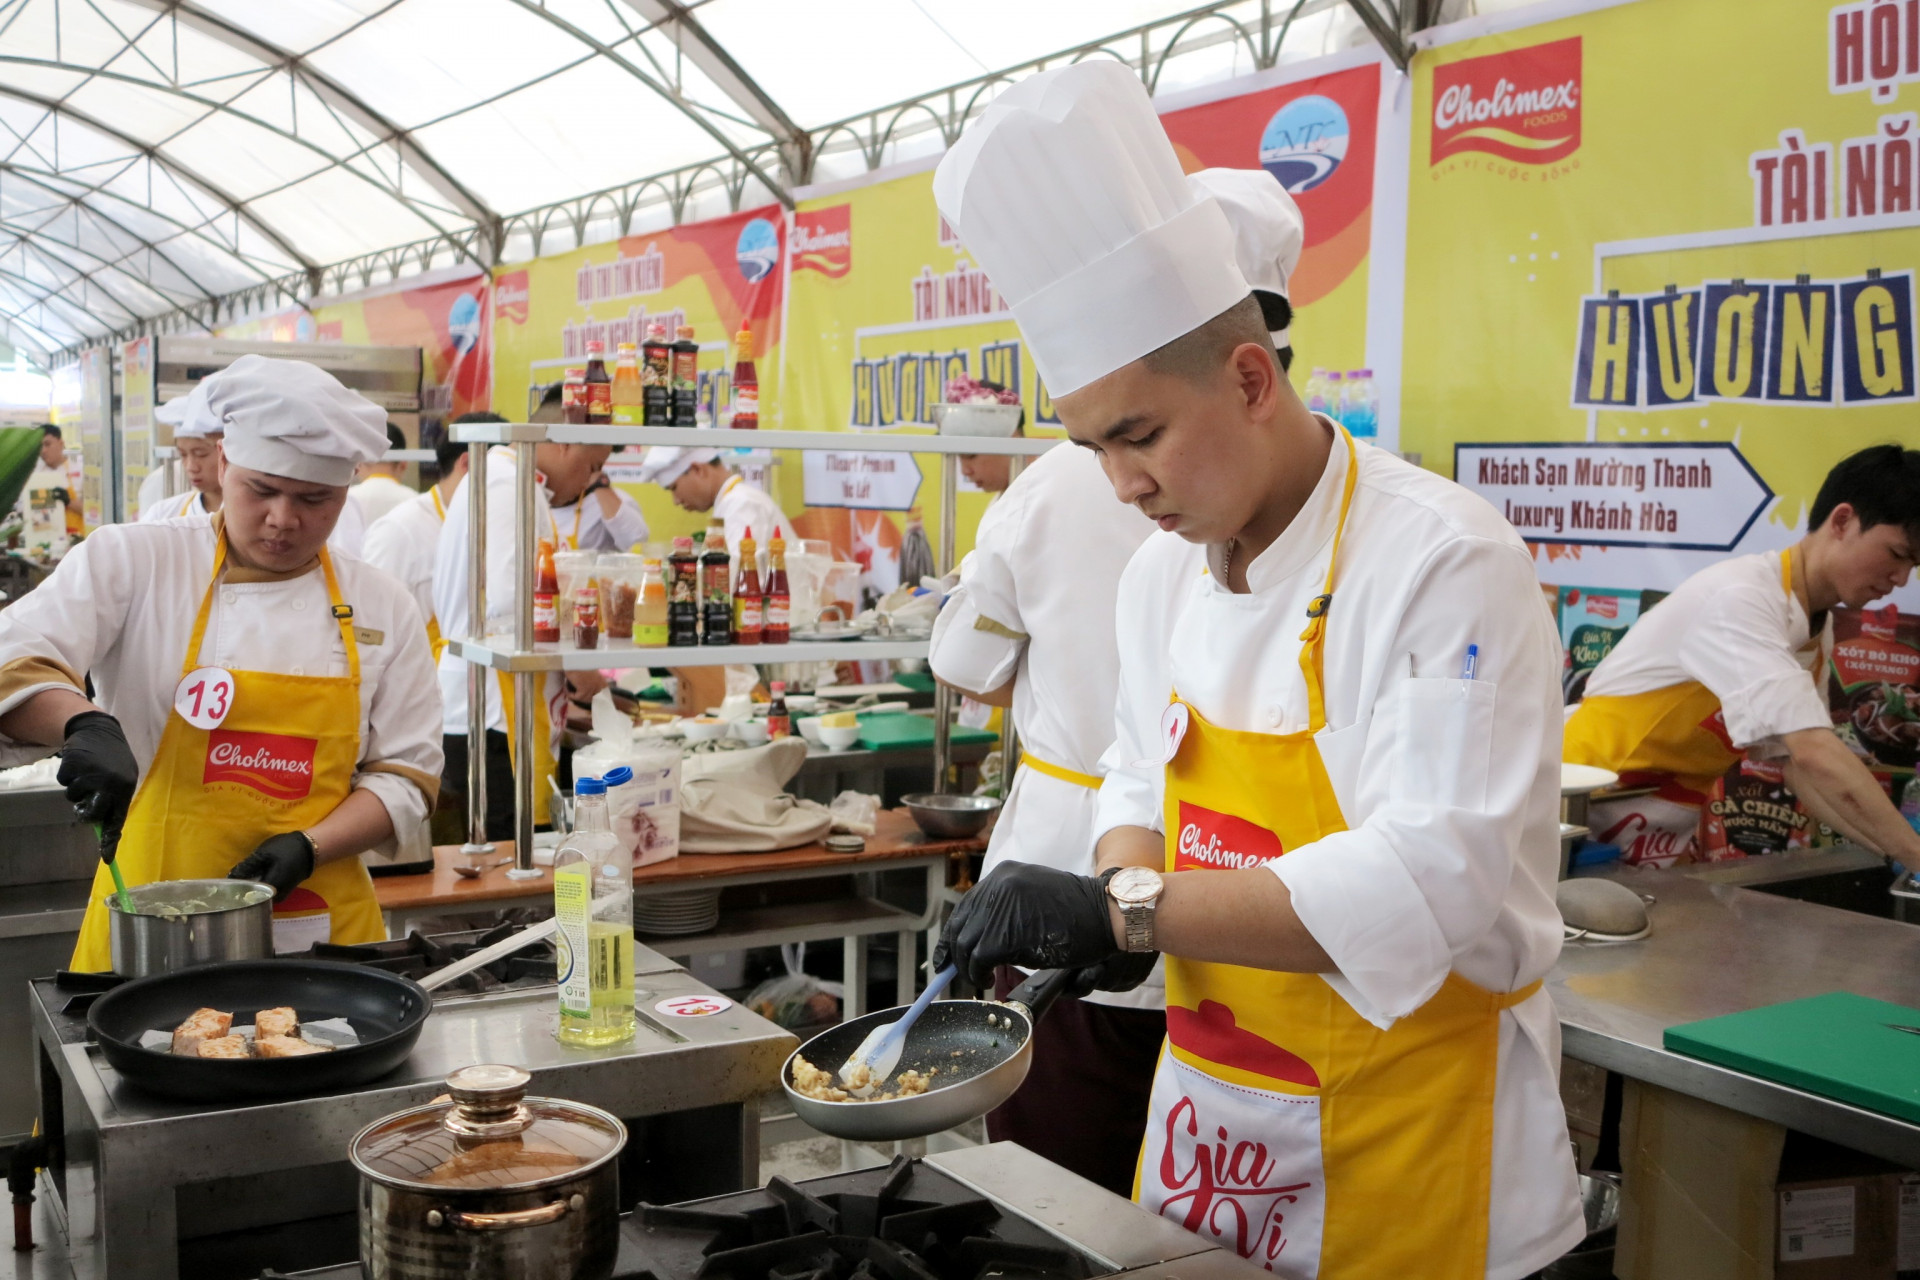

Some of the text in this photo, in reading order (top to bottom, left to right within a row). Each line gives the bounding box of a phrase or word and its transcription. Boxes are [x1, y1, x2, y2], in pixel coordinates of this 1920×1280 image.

[1435, 78, 1577, 130] Cholimex
[1523, 110, 1568, 128] FOODS
[1755, 120, 1920, 226] TÀI NĂ
[1589, 285, 1904, 402] HƯƠNG
[1478, 457, 1712, 492] Khách Sạn Mường Thanh
[1505, 499, 1677, 533] Luxury Khánh Hòa
[1890, 653, 1920, 666] KHO
[187, 680, 229, 720] 13
[210, 742, 310, 775] Cholimex
[1710, 795, 1740, 815] GÀ
[1159, 1095, 1311, 1234] Gia
[1209, 1194, 1298, 1272] Vị
